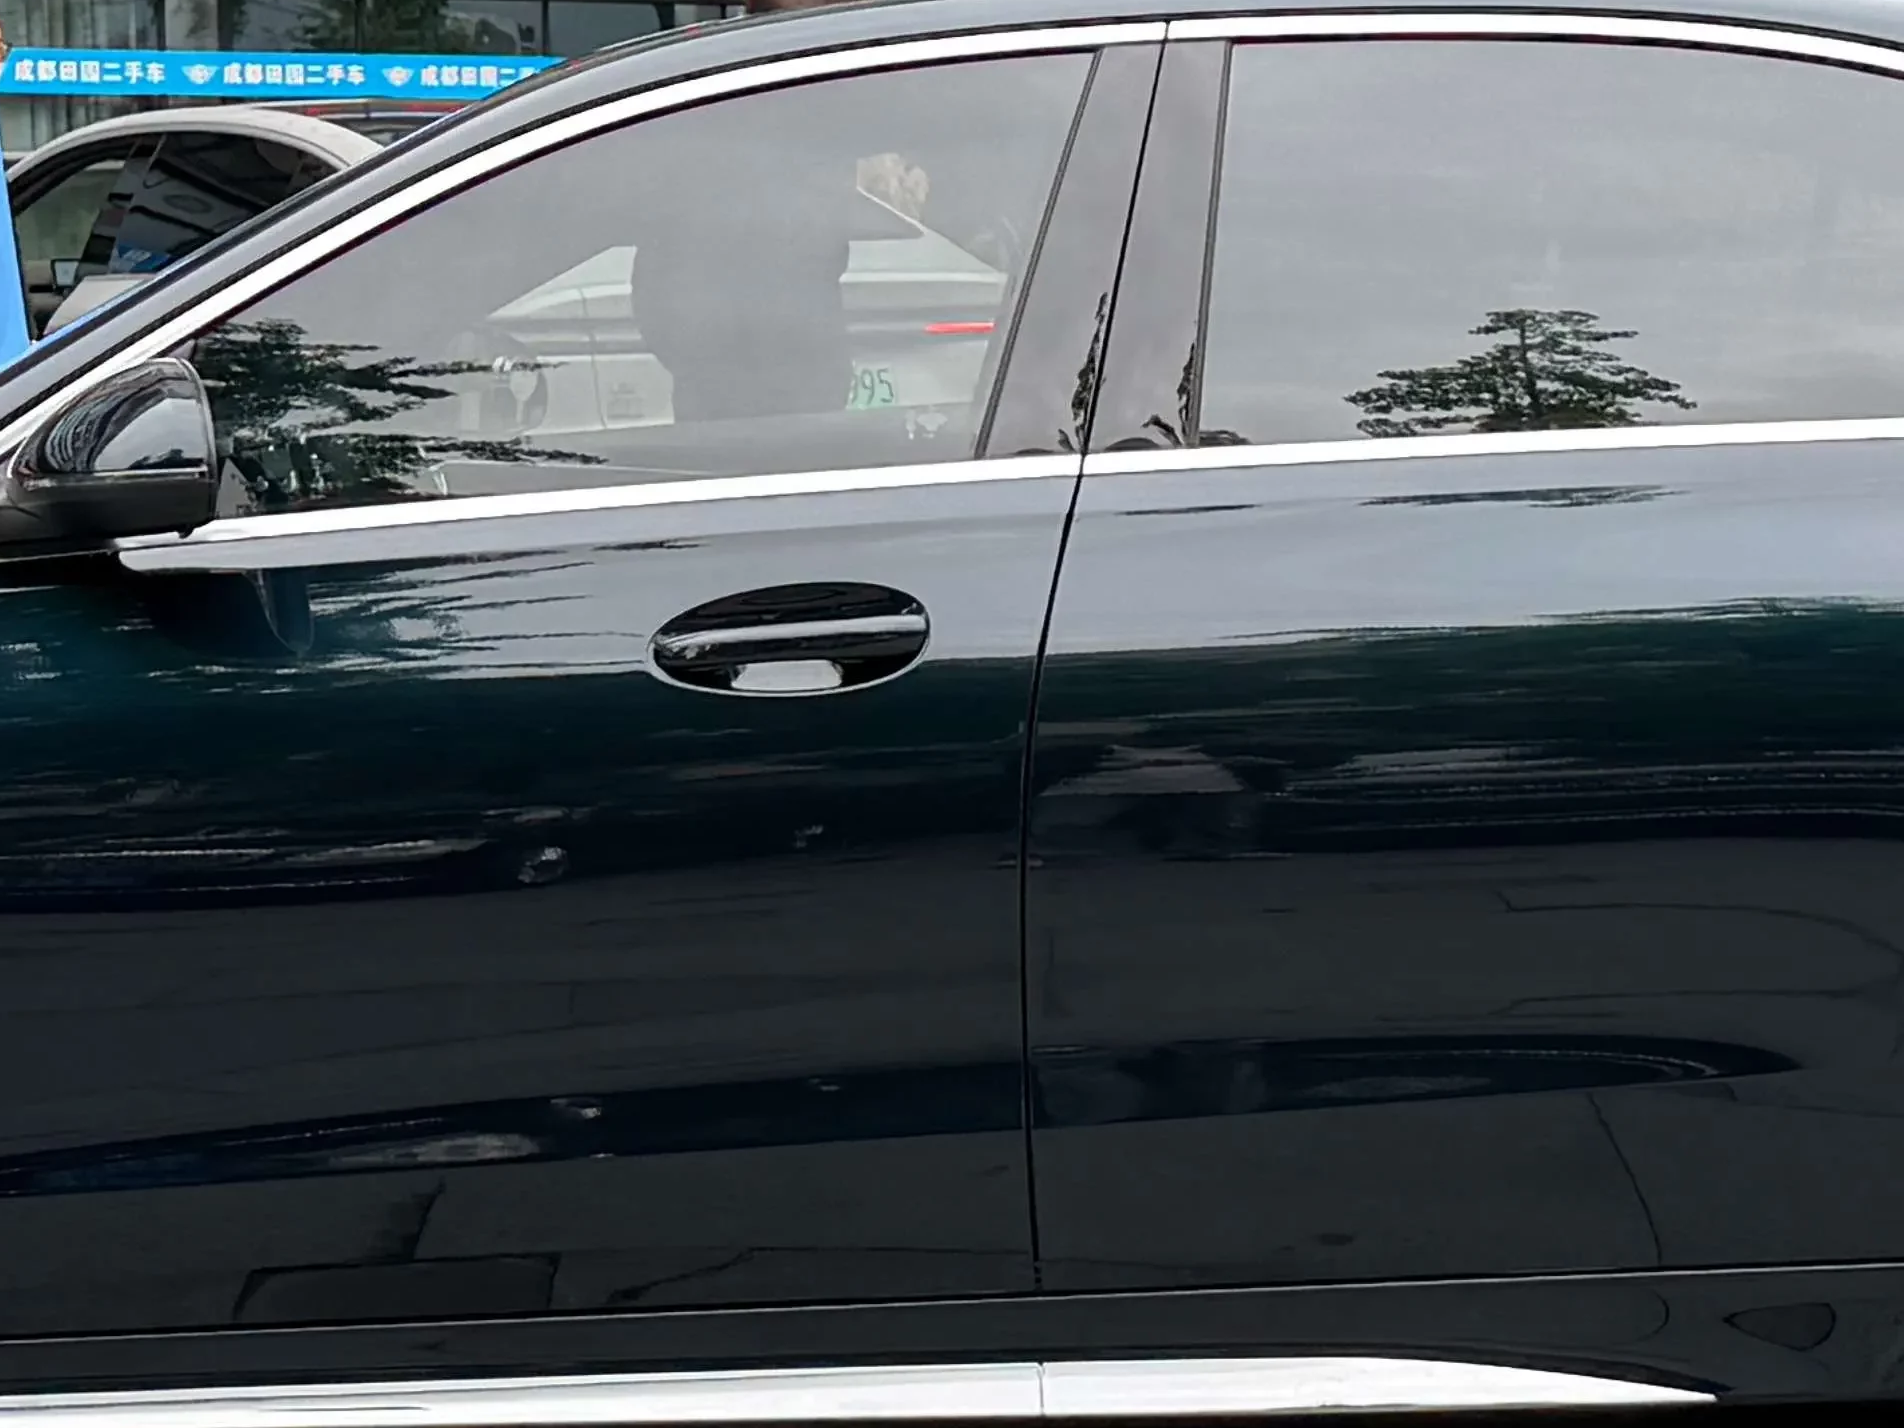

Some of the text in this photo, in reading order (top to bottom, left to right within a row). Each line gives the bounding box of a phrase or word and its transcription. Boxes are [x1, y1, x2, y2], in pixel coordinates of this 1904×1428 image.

[14, 59, 167, 84] 成都田园二手车
[223, 60, 367, 85] 成都田园二手车
